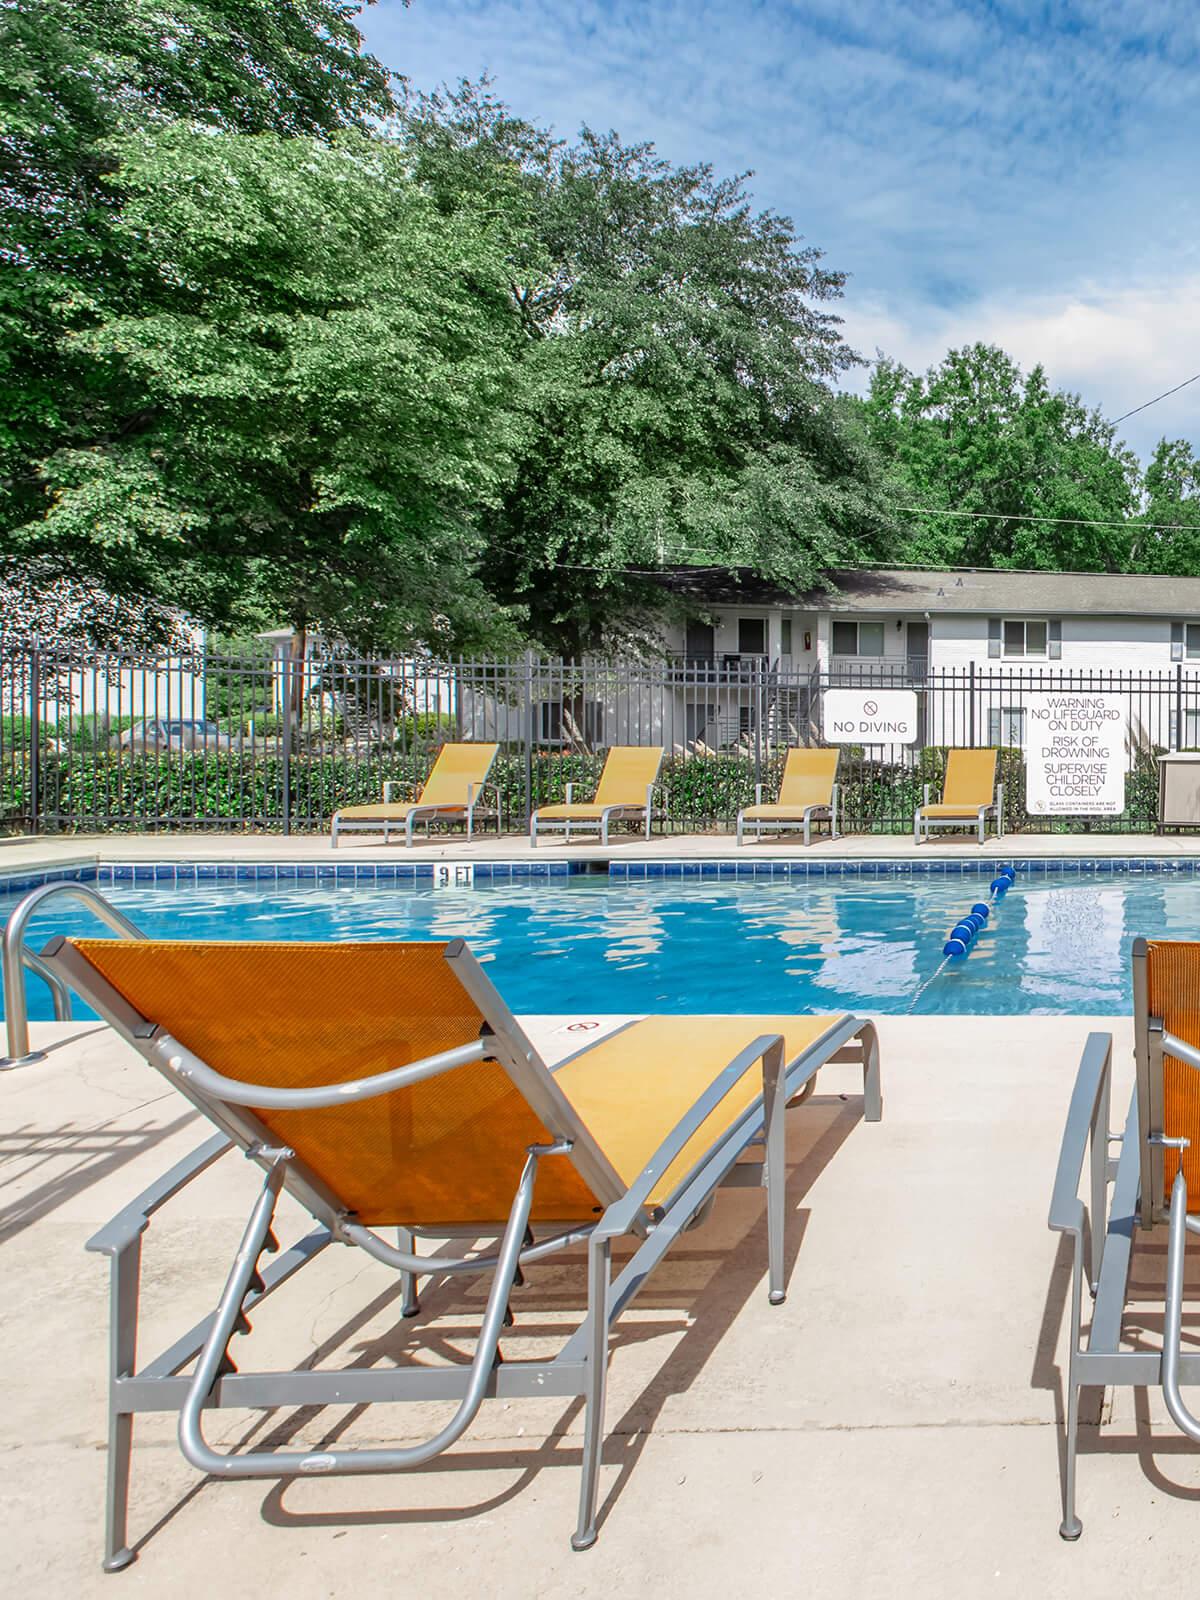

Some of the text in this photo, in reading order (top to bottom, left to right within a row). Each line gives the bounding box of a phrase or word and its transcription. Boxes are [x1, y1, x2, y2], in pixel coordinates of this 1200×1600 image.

[1046, 698, 1105, 709] WARNING
[1031, 709, 1121, 720] NO LIFEGUARD
[833, 721, 908, 733] NO DIVING
[1048, 720, 1104, 731] ON DUTY
[1052, 736, 1099, 747] RISK OF
[1041, 747, 1110, 759] DROWNING
[1043, 763, 1108, 774] SUPERVISE
[1045, 774, 1106, 785] CHILDREN
[1049, 785, 1102, 797] CLOSELY
[455, 866, 472, 883] FT
